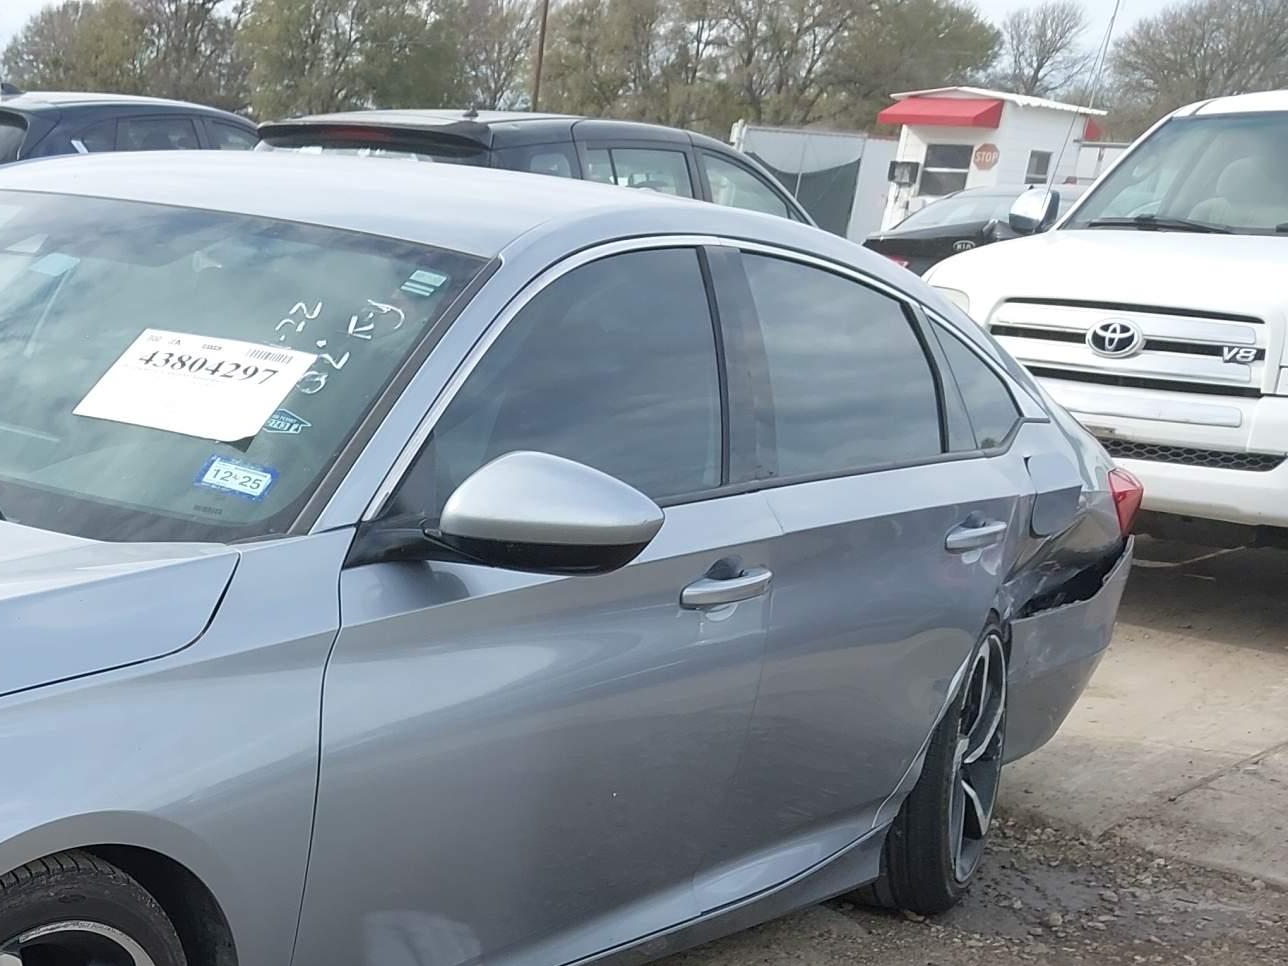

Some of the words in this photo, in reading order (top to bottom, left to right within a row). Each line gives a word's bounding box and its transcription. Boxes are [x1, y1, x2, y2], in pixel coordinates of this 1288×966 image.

[975, 151, 999, 163] STOP
[1222, 346, 1258, 362] V8
[139, 350, 279, 385] 43804297
